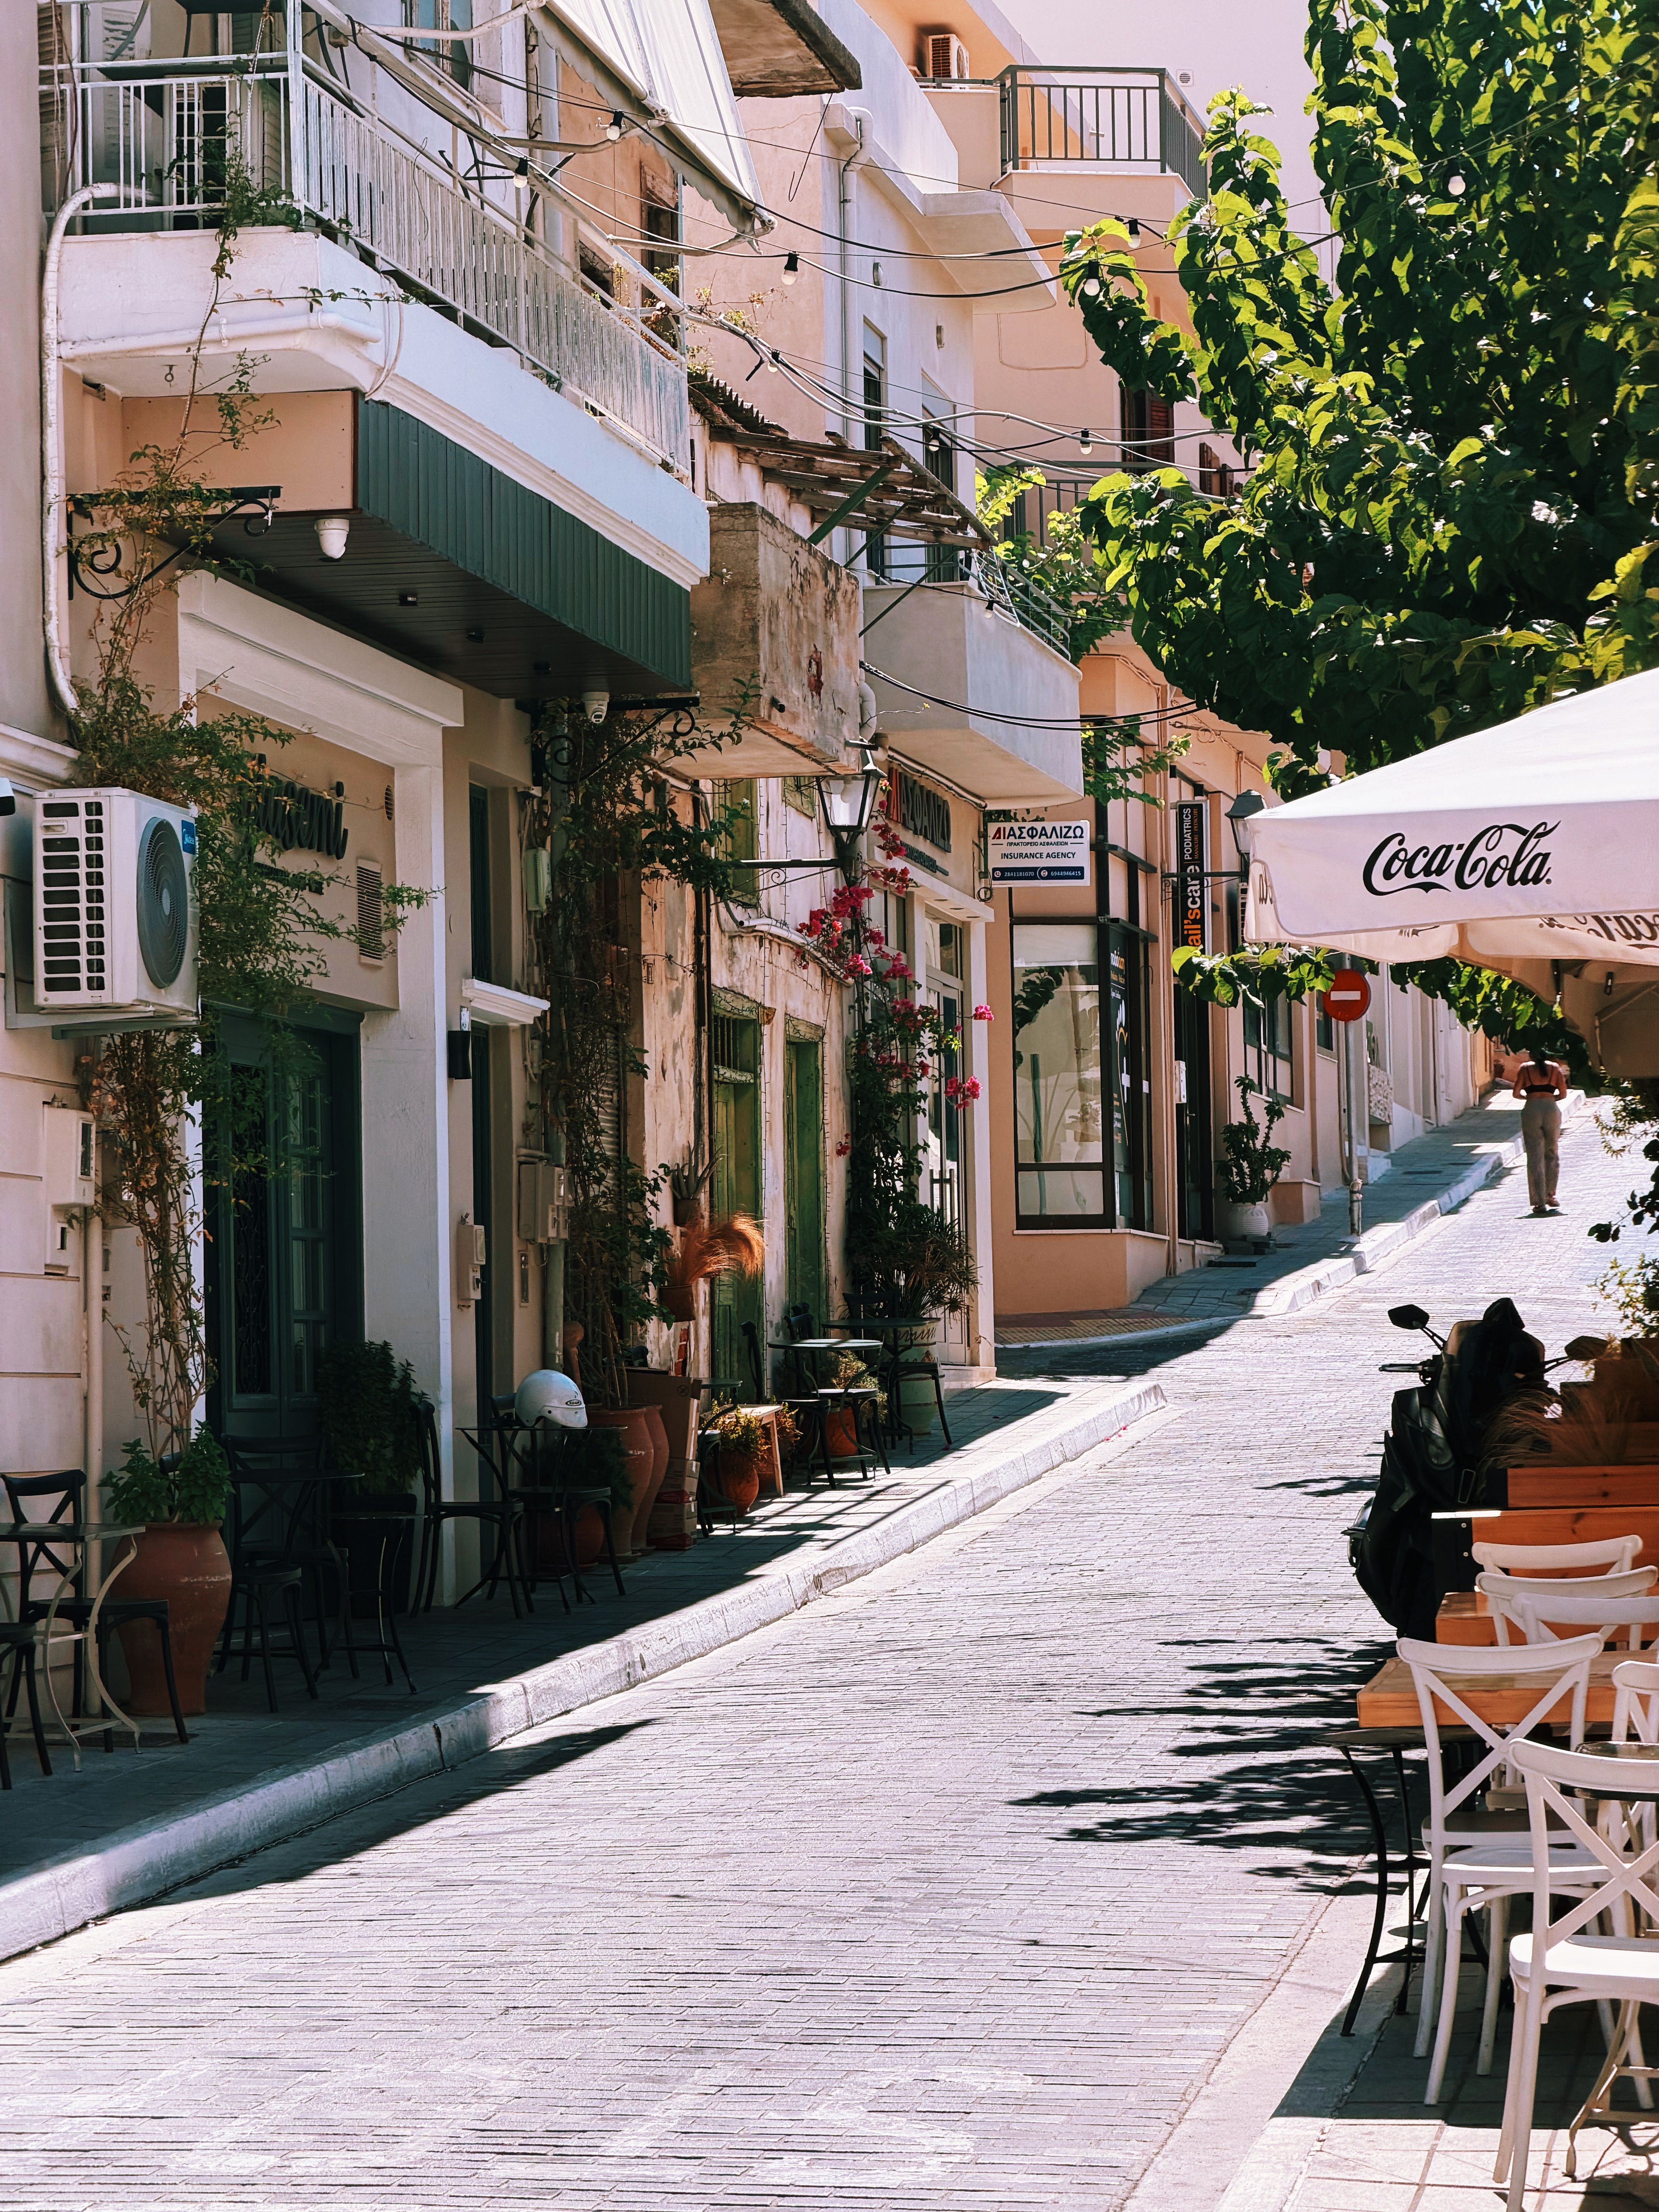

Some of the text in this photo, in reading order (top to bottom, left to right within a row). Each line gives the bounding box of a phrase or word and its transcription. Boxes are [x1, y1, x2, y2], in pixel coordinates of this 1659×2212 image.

[992, 825, 1084, 840] ΔΙΑΣΦΑΛΙΖΩ
[1183, 808, 1192, 860] PODIATRICS
[1363, 820, 1561, 896] Coca-Cola
